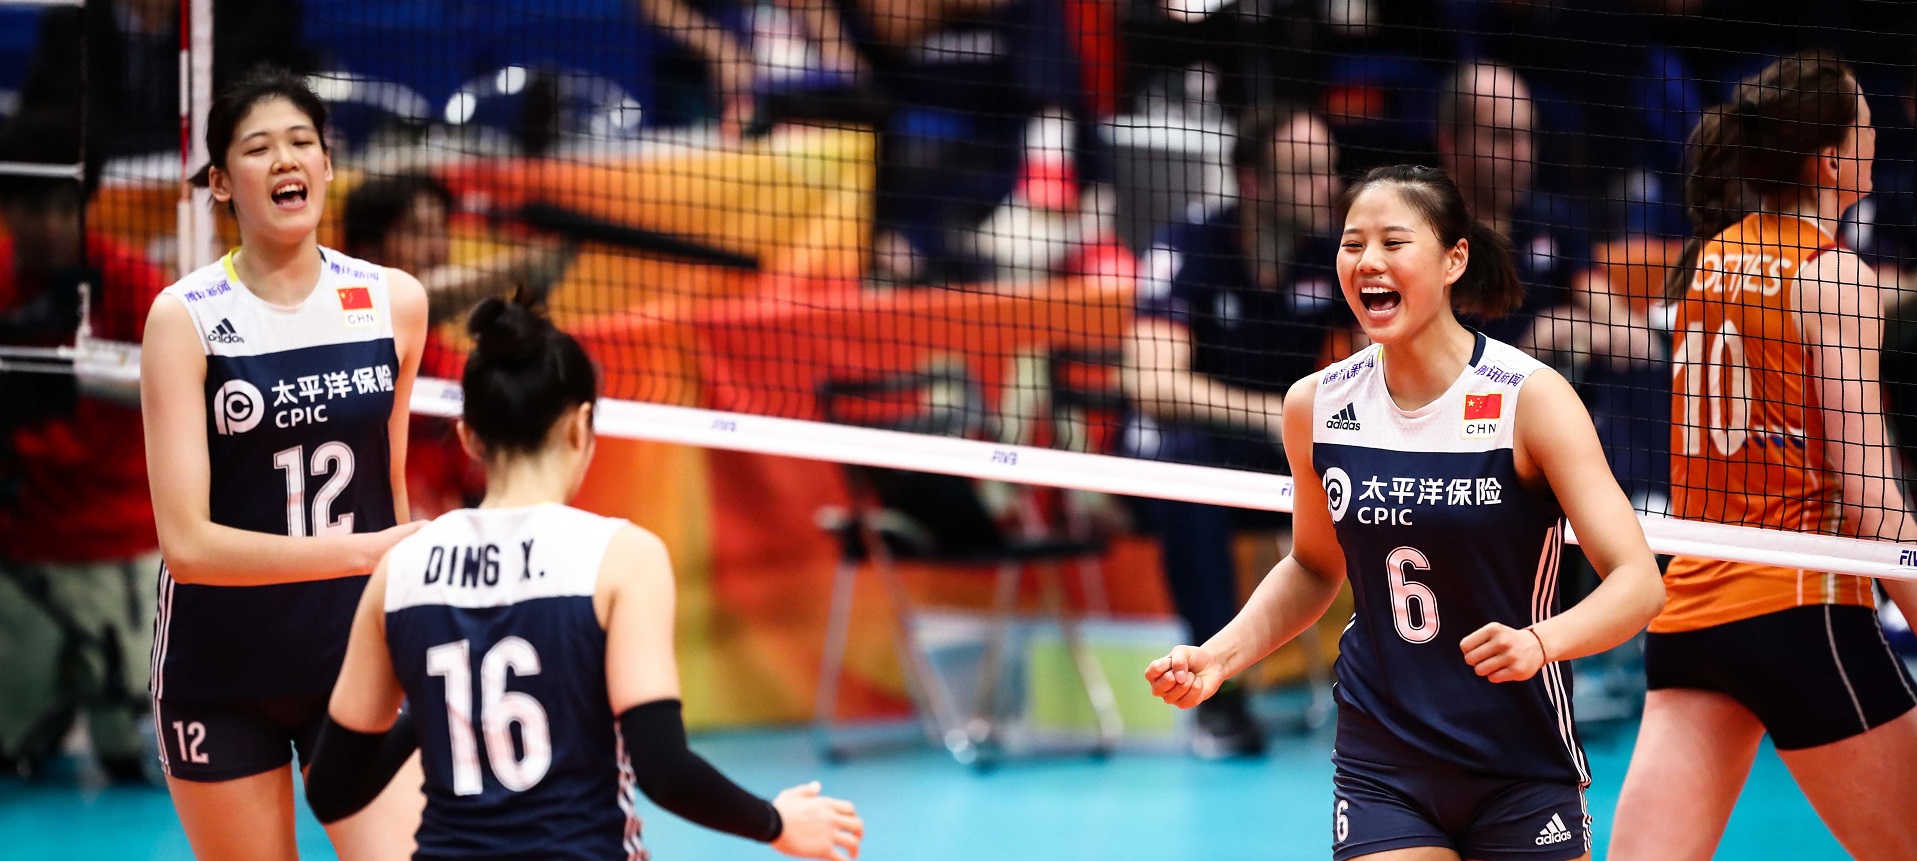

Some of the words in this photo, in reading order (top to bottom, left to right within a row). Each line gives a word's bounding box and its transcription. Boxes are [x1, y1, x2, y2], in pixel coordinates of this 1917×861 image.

[347, 313, 374, 325] CHN
[208, 332, 245, 344] adidas
[271, 363, 394, 407] 太平洋保险
[1474, 364, 1525, 387] 腾讯新闻
[1673, 320, 1752, 457] 10
[275, 405, 328, 429] CPIC
[1326, 419, 1361, 431] adidas
[1466, 423, 1497, 435] CHN
[273, 440, 355, 537] 12
[1358, 475, 1502, 506] 太平洋保险
[1357, 506, 1413, 526] CPIC
[424, 543, 500, 589] DING
[1385, 545, 1440, 644] 6
[426, 635, 552, 796] 16
[172, 720, 210, 764] 12
[1336, 799, 1349, 843] 6
[1535, 829, 1572, 846] adidas
